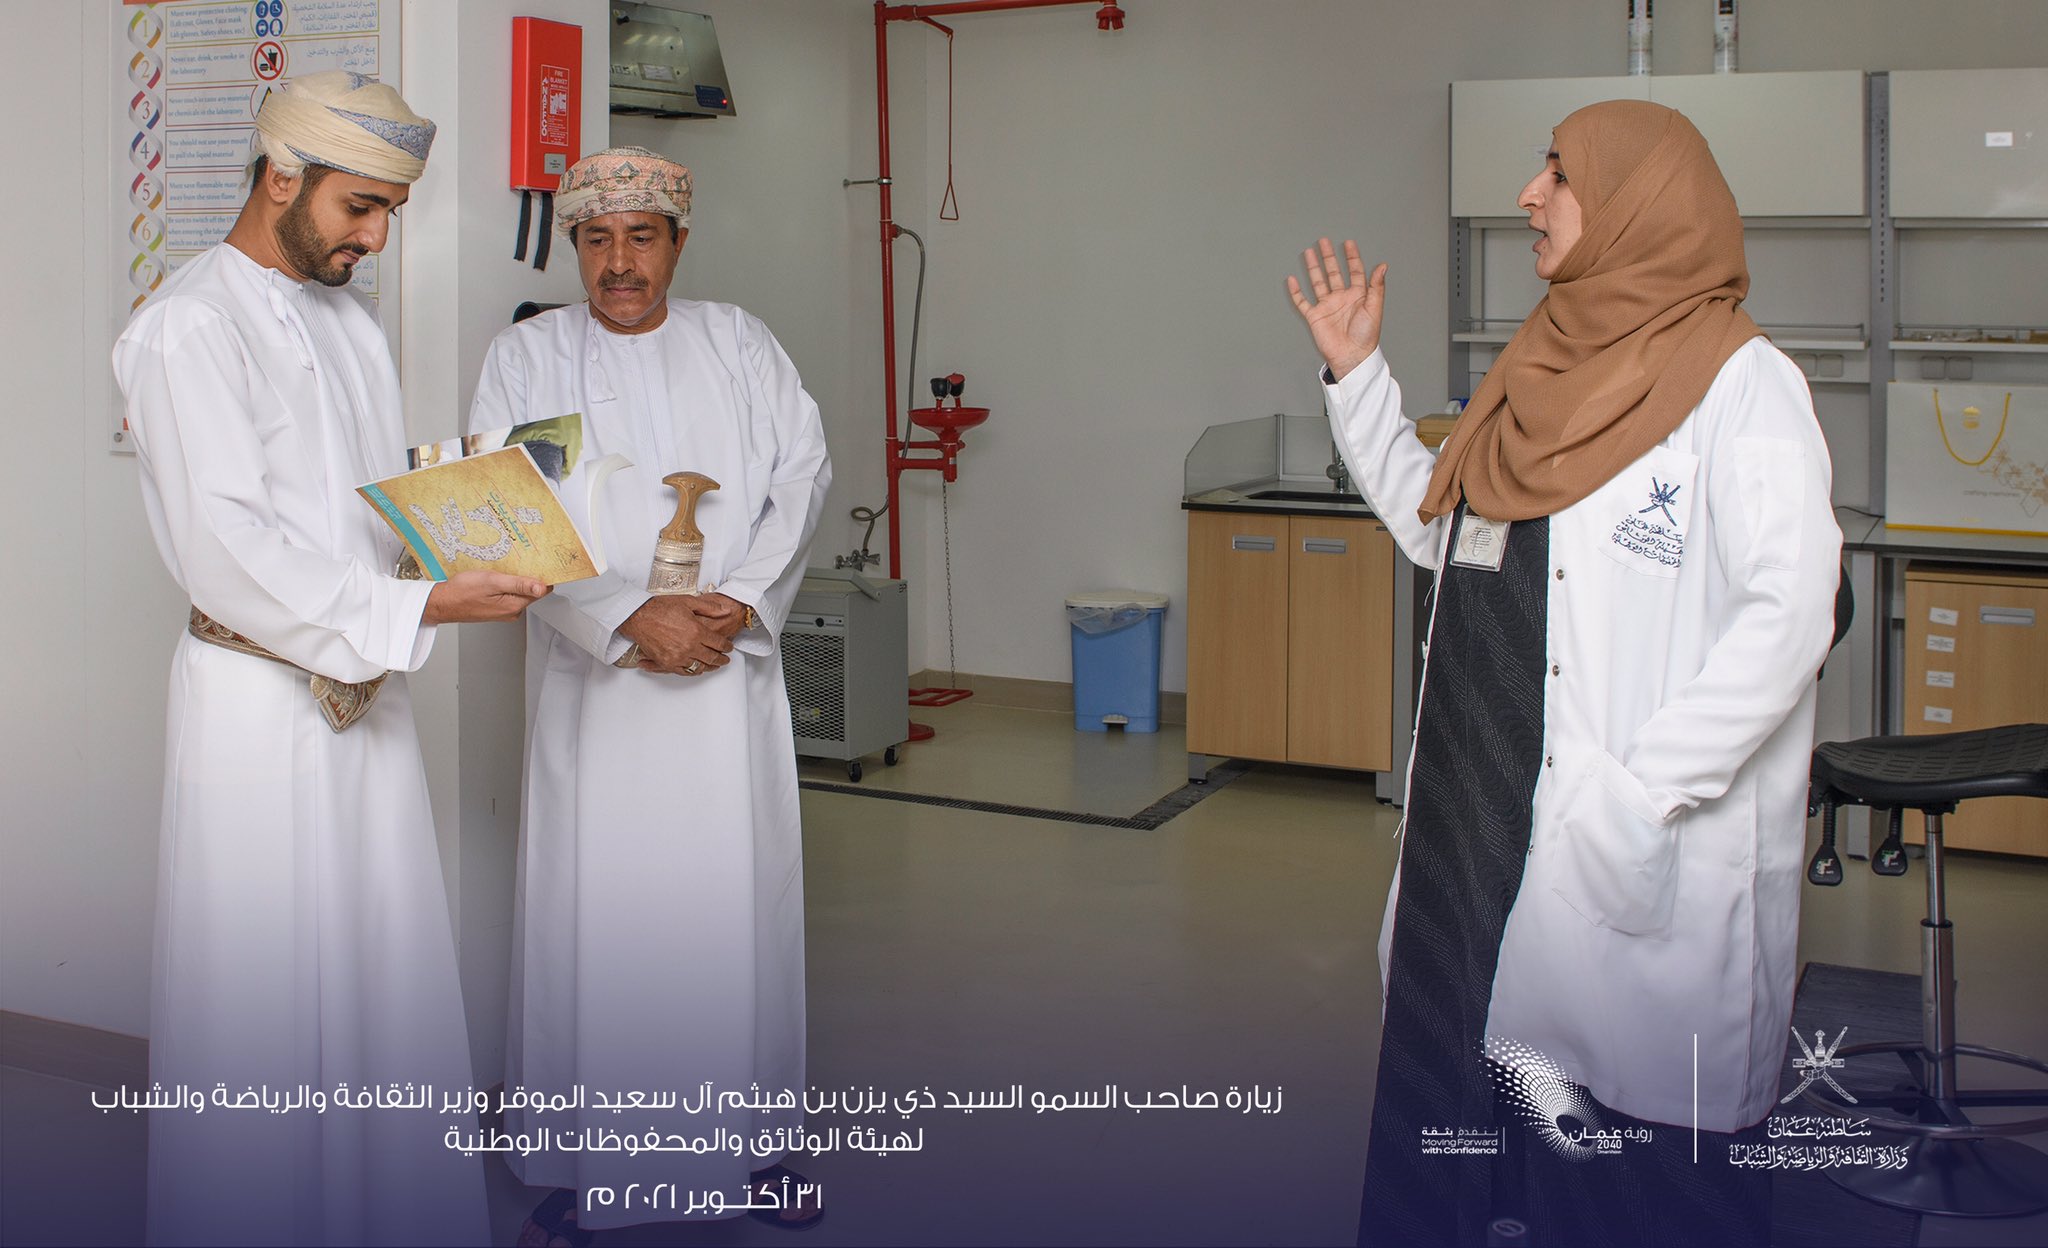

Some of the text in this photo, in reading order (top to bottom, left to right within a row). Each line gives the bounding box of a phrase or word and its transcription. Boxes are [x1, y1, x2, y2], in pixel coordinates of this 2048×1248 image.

[143, 19, 148, 38] 1
[141, 60, 150, 79] 2
[142, 101, 150, 120] 3
[140, 141, 150, 159] 4
[142, 183, 150, 201] 5
[142, 222, 151, 241] 6
[144, 265, 152, 282] 7
